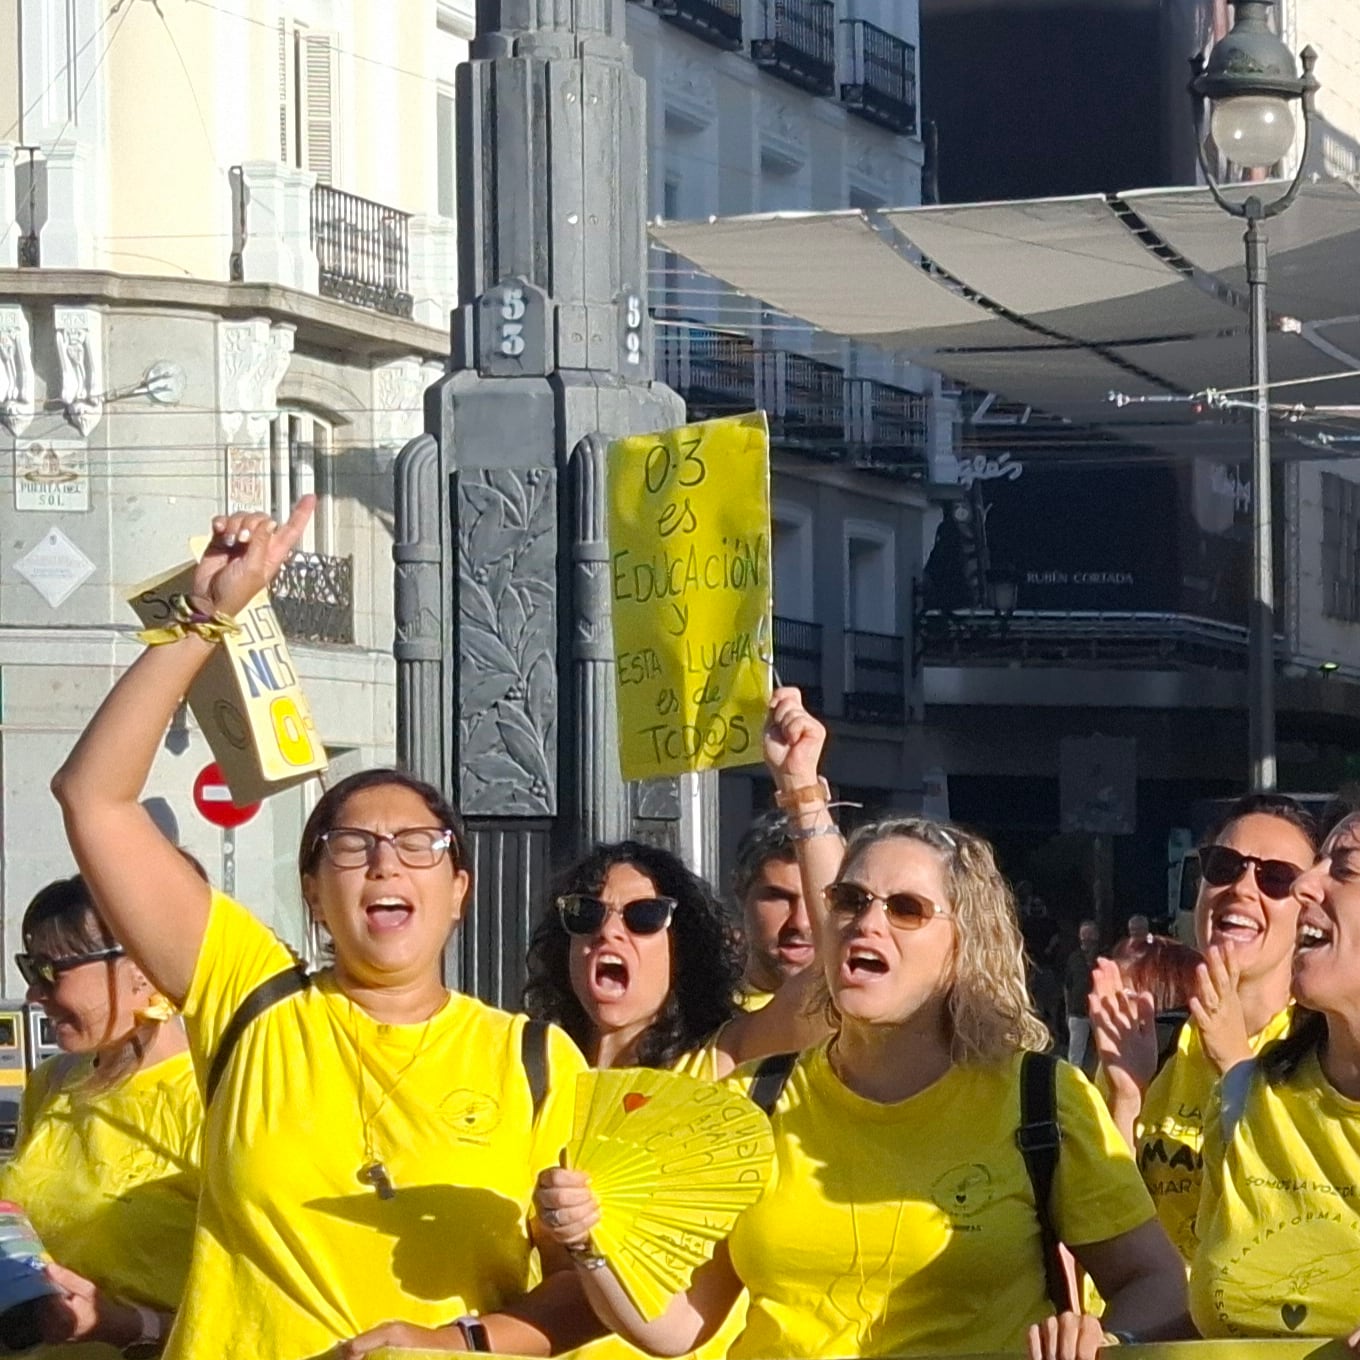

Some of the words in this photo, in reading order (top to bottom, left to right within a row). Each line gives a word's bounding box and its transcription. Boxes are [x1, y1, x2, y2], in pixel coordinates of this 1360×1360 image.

[38, 495, 65, 507] SOL
[657, 498, 698, 538] es
[1073, 572, 1134, 585] CORTADA
[616, 648, 663, 686] ESTA
[686, 634, 752, 673] LUCHA
[656, 687, 680, 716] es
[692, 670, 722, 706] de
